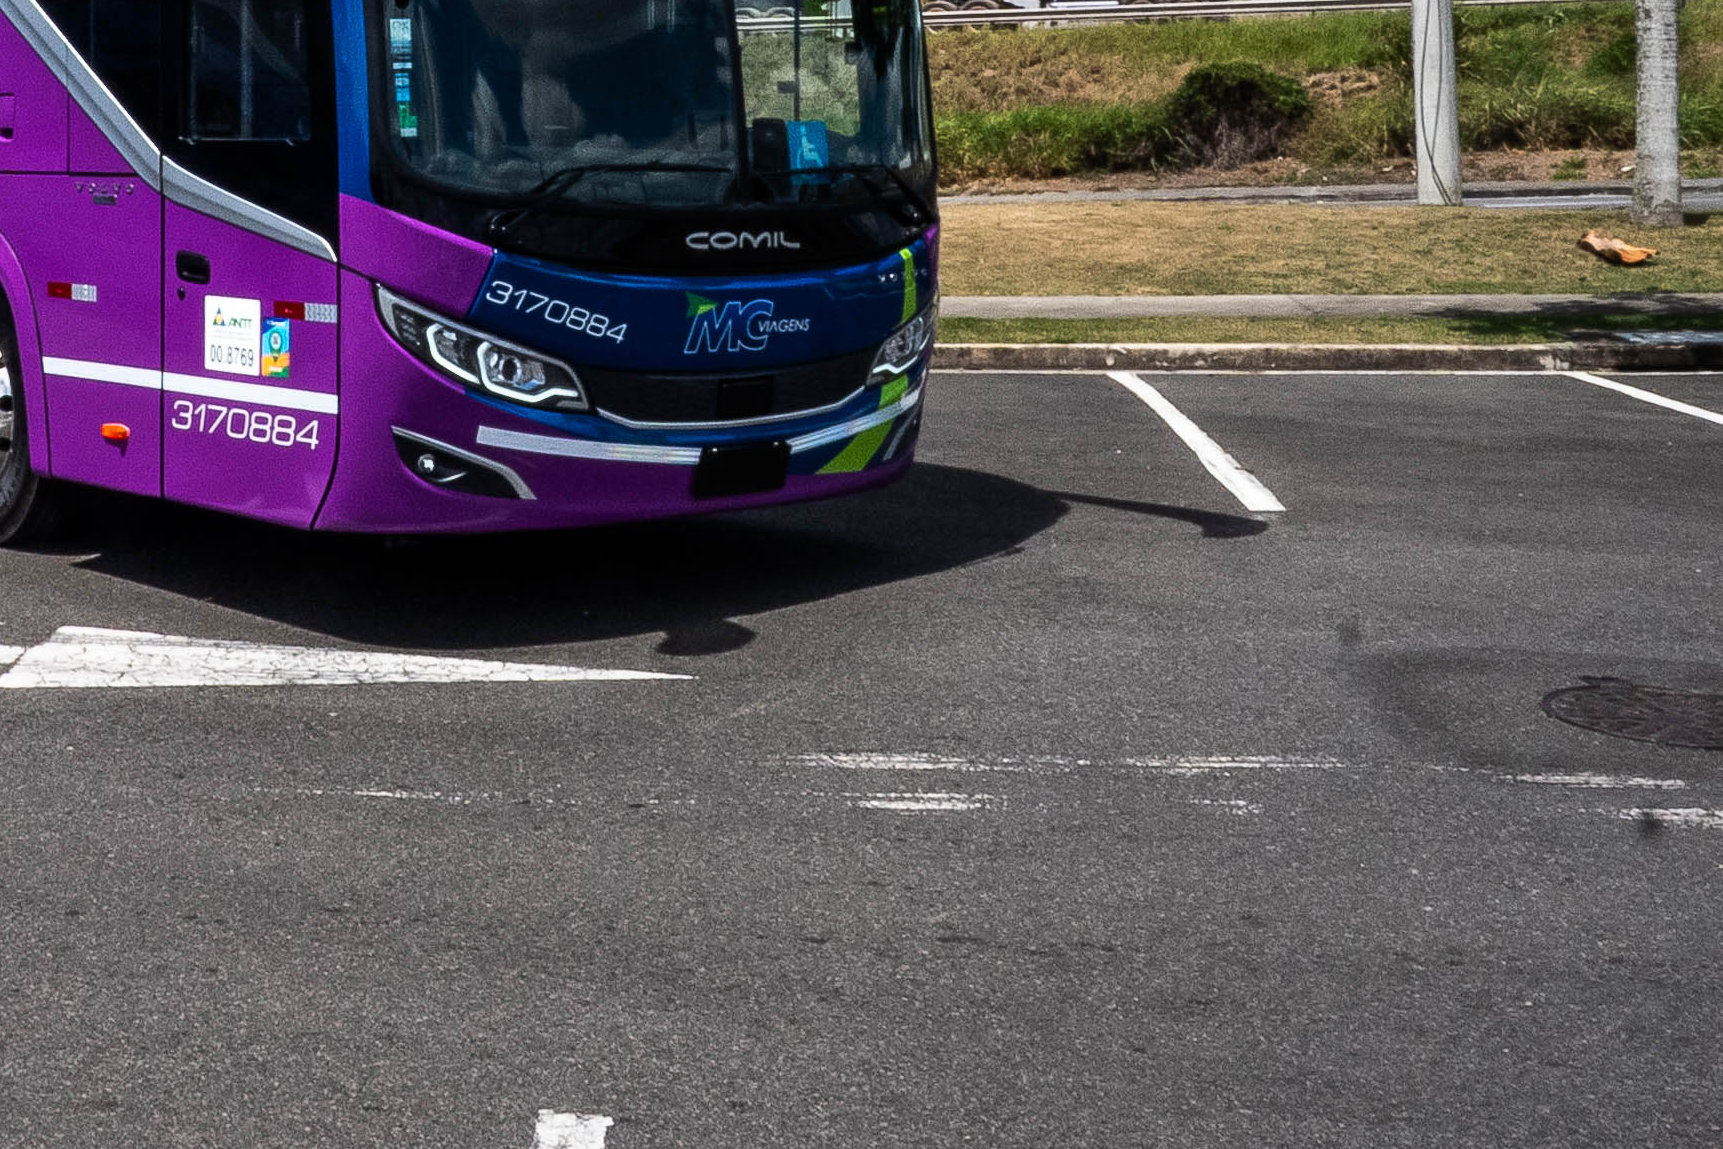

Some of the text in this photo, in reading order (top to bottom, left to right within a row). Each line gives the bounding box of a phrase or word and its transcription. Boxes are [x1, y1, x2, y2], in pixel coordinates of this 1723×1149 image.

[685, 231, 801, 250] COMIL
[485, 280, 628, 345] 3170884
[683, 298, 811, 355] MC VIAGENS
[171, 400, 320, 451] 3170884
